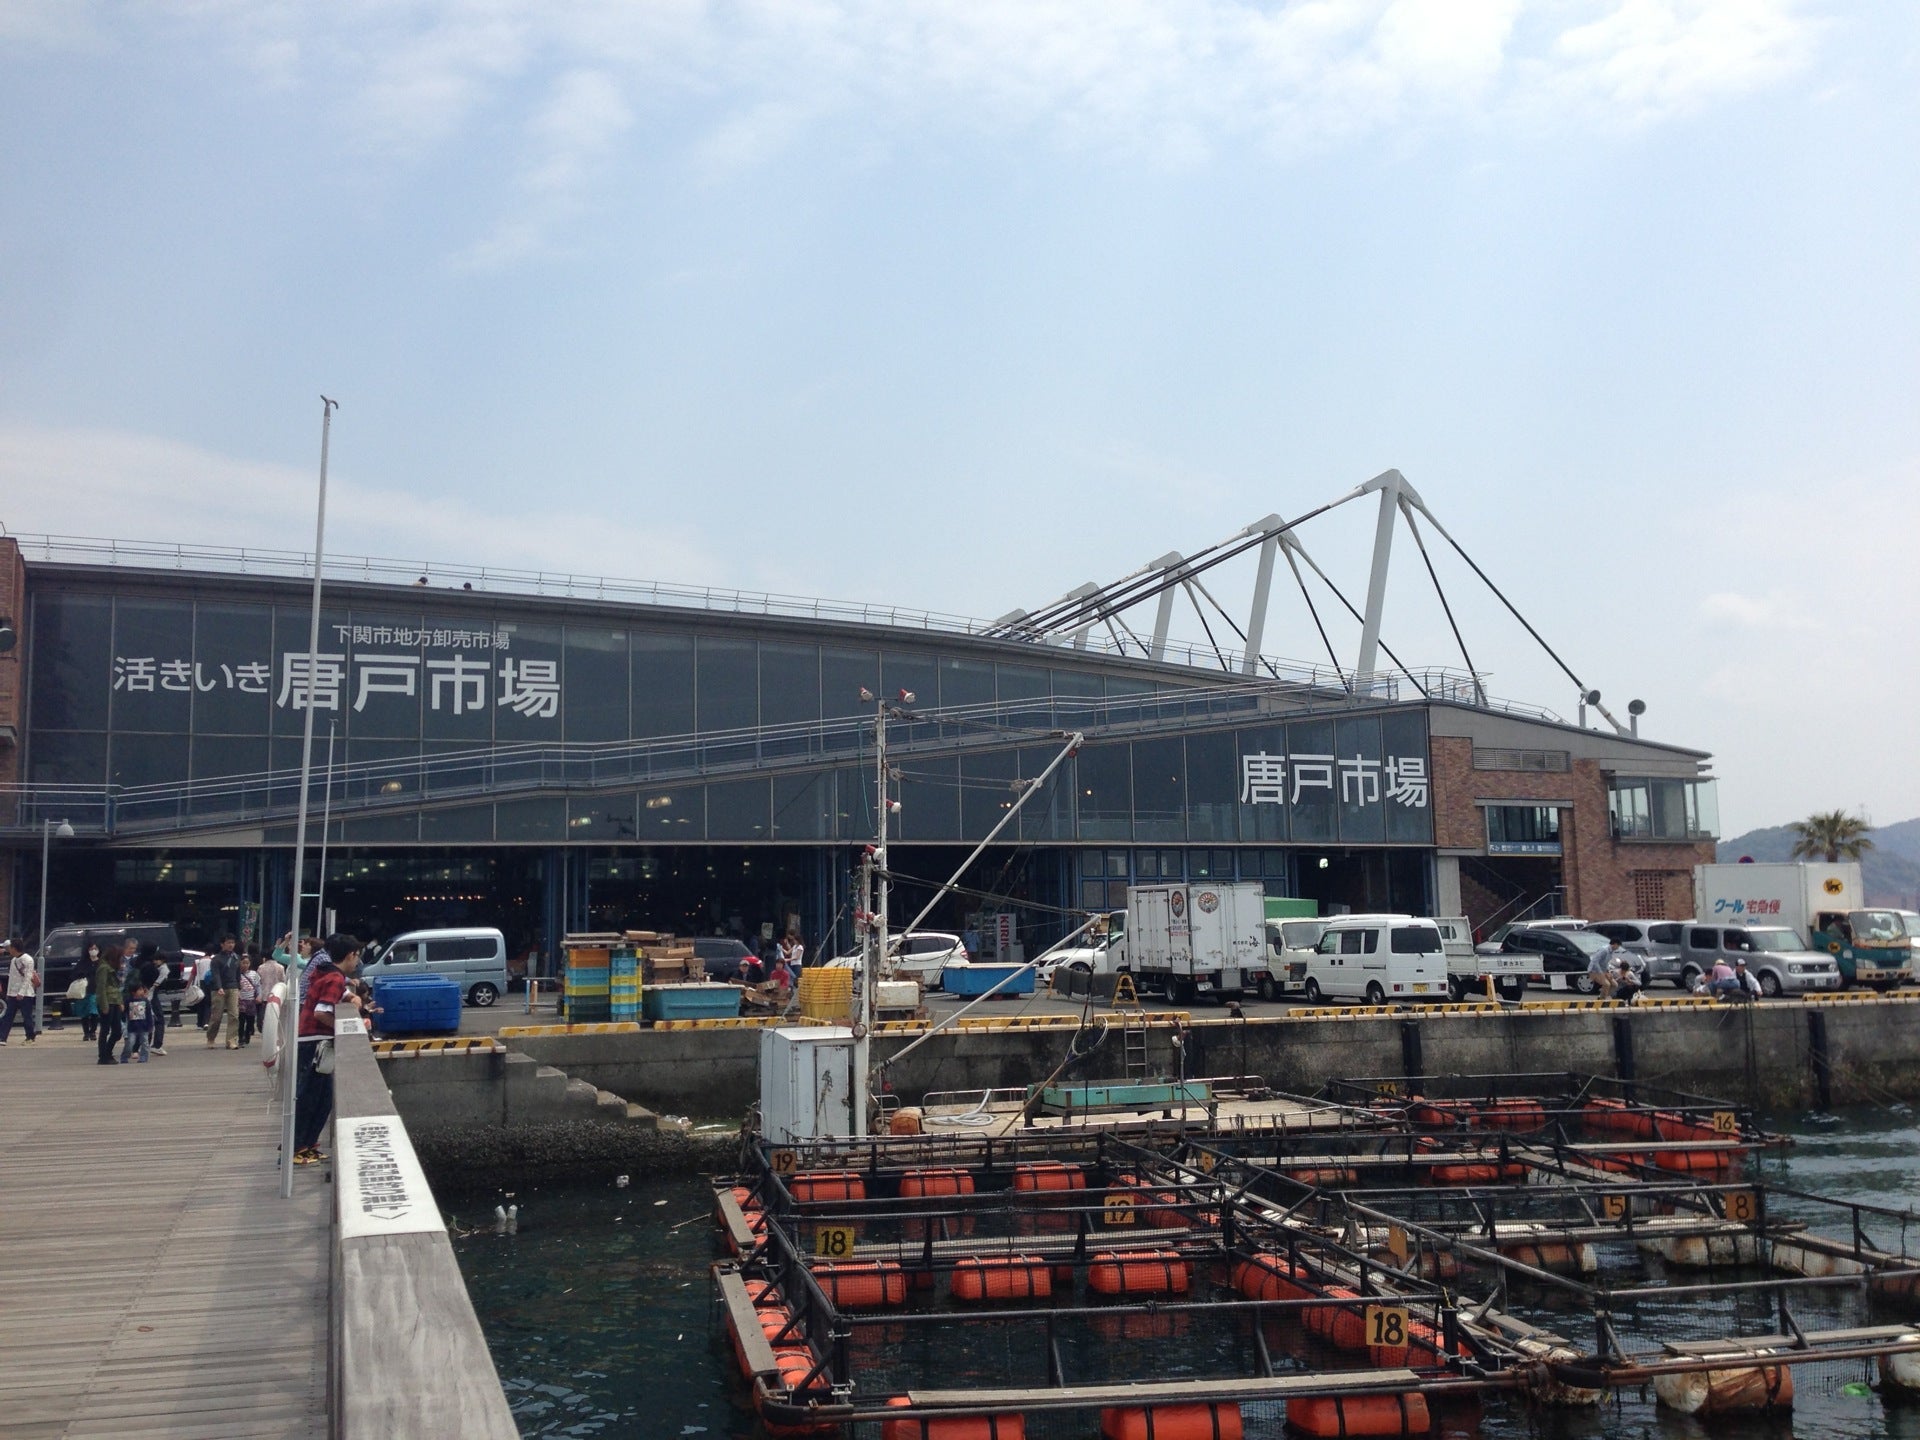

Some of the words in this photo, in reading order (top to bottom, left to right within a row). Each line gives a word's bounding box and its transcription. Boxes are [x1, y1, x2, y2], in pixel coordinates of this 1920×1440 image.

[332, 624, 510, 650] 下関市地方卸売市場
[276, 652, 561, 718] 唐戸市場
[1240, 750, 1428, 808] 唐戸市場
[1717, 1115, 1732, 1130] 16
[776, 1152, 793, 1171] 19
[1610, 1196, 1623, 1216] 5
[1736, 1195, 1749, 1219] 8
[821, 1230, 846, 1256] 18
[1374, 1311, 1404, 1345] 18
